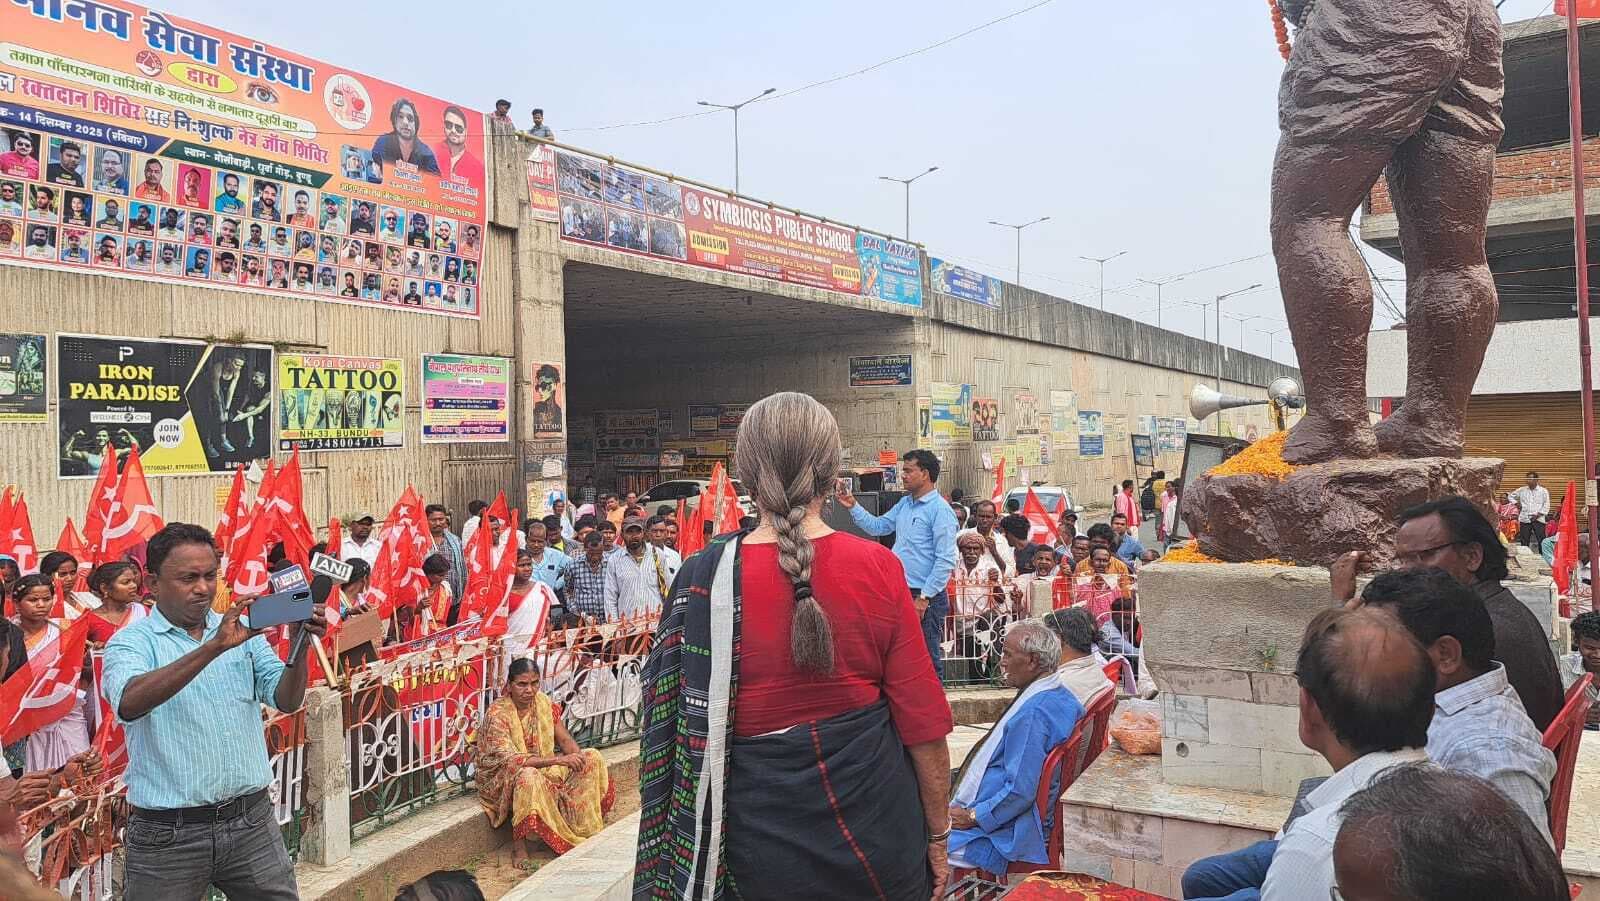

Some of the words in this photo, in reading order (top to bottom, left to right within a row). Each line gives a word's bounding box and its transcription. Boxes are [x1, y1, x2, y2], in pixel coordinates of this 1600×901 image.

[143, 12, 219, 63] सेवा
[230, 44, 314, 92] संस्था
[9, 49, 44, 67] तमाम
[154, 84, 165, 97] के
[168, 90, 204, 108] सहयोग
[207, 97, 216, 110] से
[218, 102, 254, 119] लगातार
[20, 77, 88, 108] रक्तदान
[93, 90, 141, 120] शिविर
[144, 106, 171, 128] सह
[293, 139, 328, 163] शिविर
[18, 112, 31, 122] 14
[36, 112, 73, 132] दिसम्बर
[75, 124, 102, 137] 2025
[106, 128, 148, 149] (रविवार)
[702, 196, 772, 234] SYMBIOSIS
[775, 215, 813, 244] PUBLIC
[816, 227, 854, 253] SCHOOL
[692, 234, 727, 251] ADMISSION
[863, 236, 880, 250] BAL
[884, 241, 916, 261] VATIKA
[98, 364, 153, 380] IRON
[303, 357, 333, 368] Kora
[338, 358, 381, 370] Canvas
[288, 367, 397, 390] TATTOO
[69, 382, 181, 402] PARADISE
[159, 424, 179, 433] JOIN
[337, 429, 369, 437] BUNDU
[159, 435, 180, 443] NOW
[309, 438, 382, 449] 7348004713
[318, 558, 346, 577] ANI
